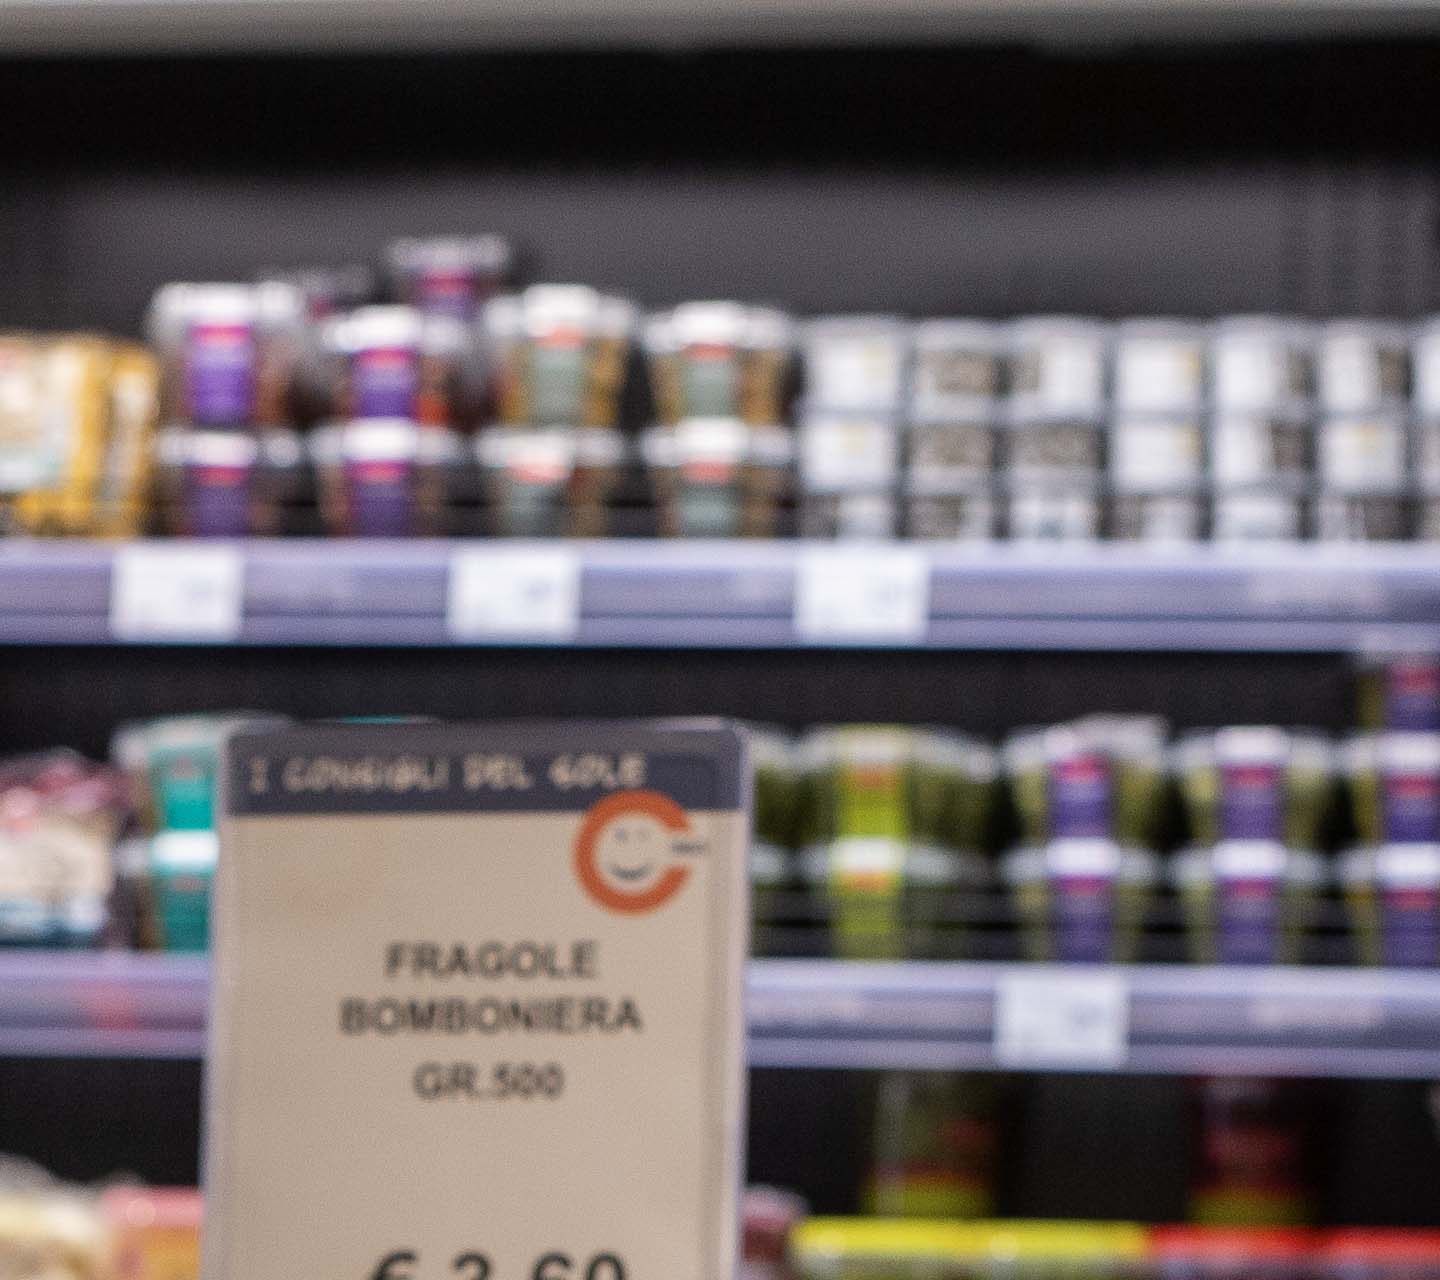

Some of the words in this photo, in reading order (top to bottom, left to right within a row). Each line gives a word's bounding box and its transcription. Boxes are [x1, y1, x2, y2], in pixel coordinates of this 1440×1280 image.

[384, 940, 599, 980] FRAGOLE
[338, 996, 644, 1036] BOMBONIERA
[413, 1061, 565, 1100] GR.500
